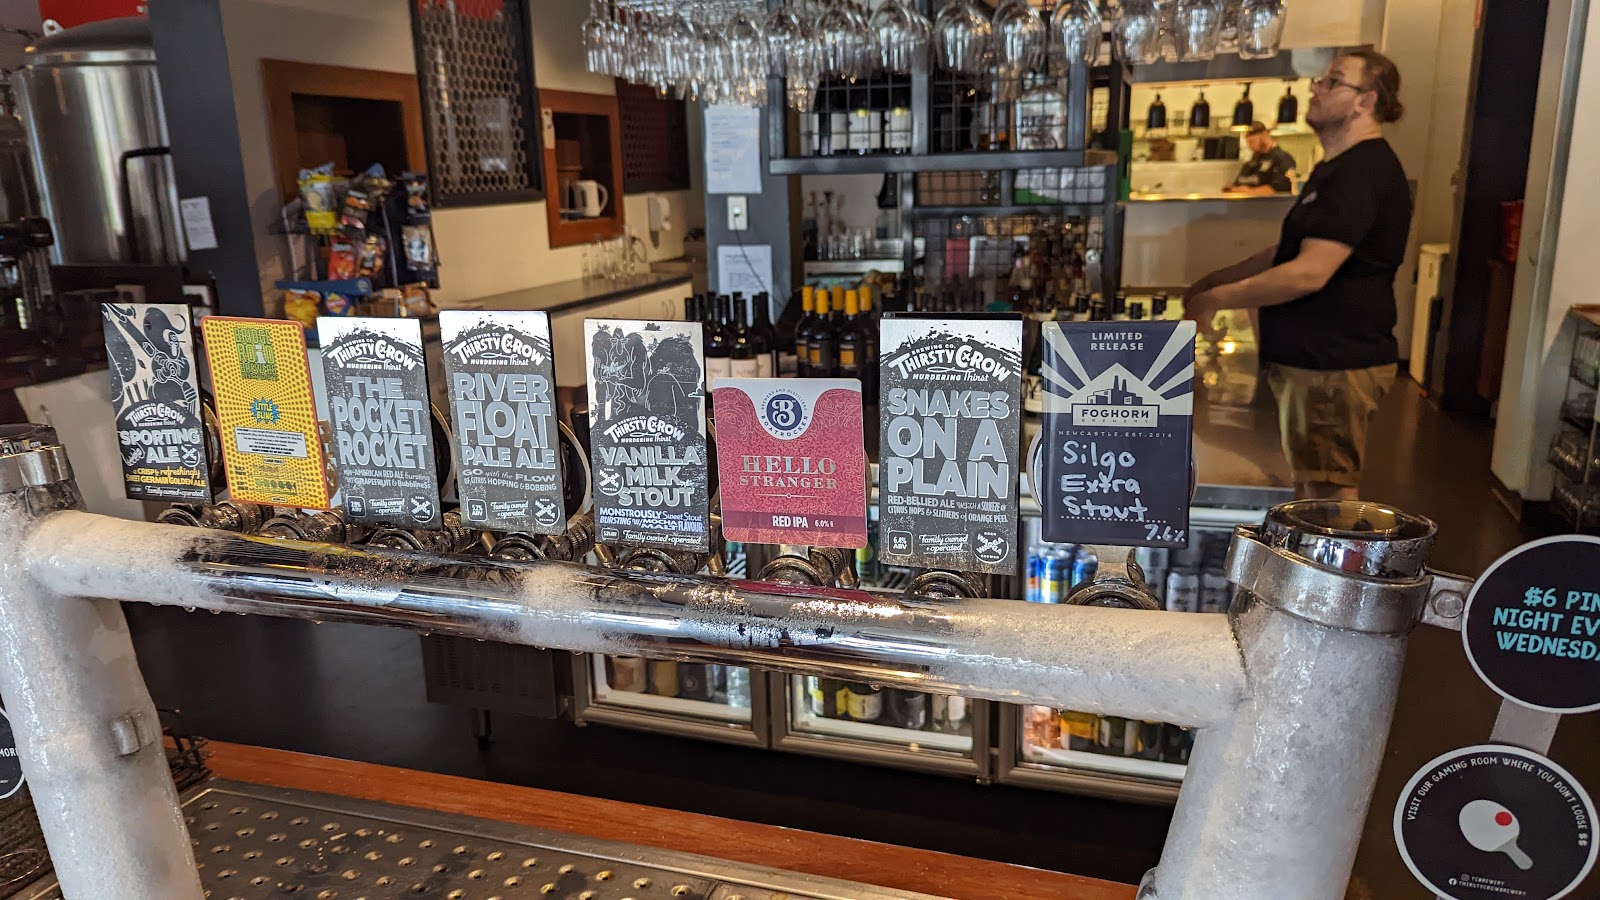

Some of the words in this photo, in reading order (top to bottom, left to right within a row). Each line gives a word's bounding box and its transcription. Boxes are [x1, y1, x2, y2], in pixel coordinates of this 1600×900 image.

[233, 327, 271, 344] BRIDGE
[467, 333, 491, 342] BREWING
[1092, 332, 1143, 340] LIMITED
[327, 343, 375, 368] THIRSTY
[375, 340, 417, 371] CROW
[451, 337, 500, 364] THIRSTY
[501, 333, 545, 366] CROW
[911, 344, 942, 355] BREWING
[1090, 342, 1144, 351] RELEASE
[888, 349, 955, 380] THIRSTY
[955, 345, 1011, 382] CROW
[912, 373, 961, 381] MURDERING
[345, 376, 404, 399] THE
[453, 372, 551, 403] RIVER
[887, 388, 1010, 420] SNAKES
[125, 406, 157, 427] THIRSTY
[157, 403, 186, 424] CROW
[332, 395, 423, 434] POCKET
[456, 400, 552, 449] FLOAT
[603, 420, 646, 443] THIRSTY
[647, 416, 685, 441] CROW
[761, 415, 808, 436] BOATROCKER
[120, 428, 200, 446] SPORTING
[887, 416, 957, 460] ON
[968, 419, 1008, 463] A
[146, 446, 181, 463] ALE
[337, 431, 427, 469] ROCKET
[461, 446, 512, 468] PALE
[516, 448, 556, 469] ALE
[599, 445, 702, 466] VANILLA
[741, 455, 836, 475] HELLO
[1063, 440, 1136, 483] Silgo
[141, 476, 169, 484] GERMAN
[169, 477, 194, 486] GOLDEN
[160, 466, 200, 479] refreshingly
[395, 470, 404, 479] ALE
[462, 468, 483, 476] GO
[485, 470, 500, 478] with
[501, 471, 513, 479] the
[515, 473, 556, 482] FLOW
[625, 466, 681, 486] MILK
[739, 475, 837, 489] STRANGER
[887, 457, 1009, 499] PLAIN
[1061, 471, 1141, 494] Extra
[470, 477, 487, 486] CITRUS
[487, 478, 519, 489] HOPPING
[525, 483, 557, 492] BOBBING
[618, 487, 695, 507] STOUT
[887, 495, 938, 507] RED-BELLIED
[940, 499, 955, 508] ALE
[980, 501, 1000, 512] SQUEEZE
[599, 507, 662, 519] MONSTROUSLY
[663, 510, 683, 520] Sweet
[683, 512, 703, 522] Stout
[887, 506, 908, 515] CITRUS
[909, 507, 925, 516] HOPS
[932, 509, 959, 520] SLITHERS
[968, 513, 993, 523] ORANGE
[994, 514, 1008, 523] PEEL
[1062, 495, 1148, 522] Stout
[600, 516, 631, 526] BURSTING
[678, 521, 704, 533] FLAVOUR
[772, 515, 791, 527] RED
[793, 516, 808, 528] IPA
[623, 529, 646, 543] Family
[918, 534, 943, 545] Family
[944, 534, 968, 544] owned
[1144, 523, 1185, 542] 7.6%
[1523, 586, 1557, 608] $6
[1492, 607, 1564, 632] NIGHT
[1407, 797, 1421, 821] VISIT
[1417, 780, 1434, 796] OUR
[1431, 760, 1468, 782] GAMING
[1470, 756, 1498, 767] ROOM
[1502, 757, 1535, 773] WHERE
[1536, 768, 1555, 783] YOU
[1553, 781, 1577, 803] DON'T
[1571, 804, 1588, 830] LOOSE
